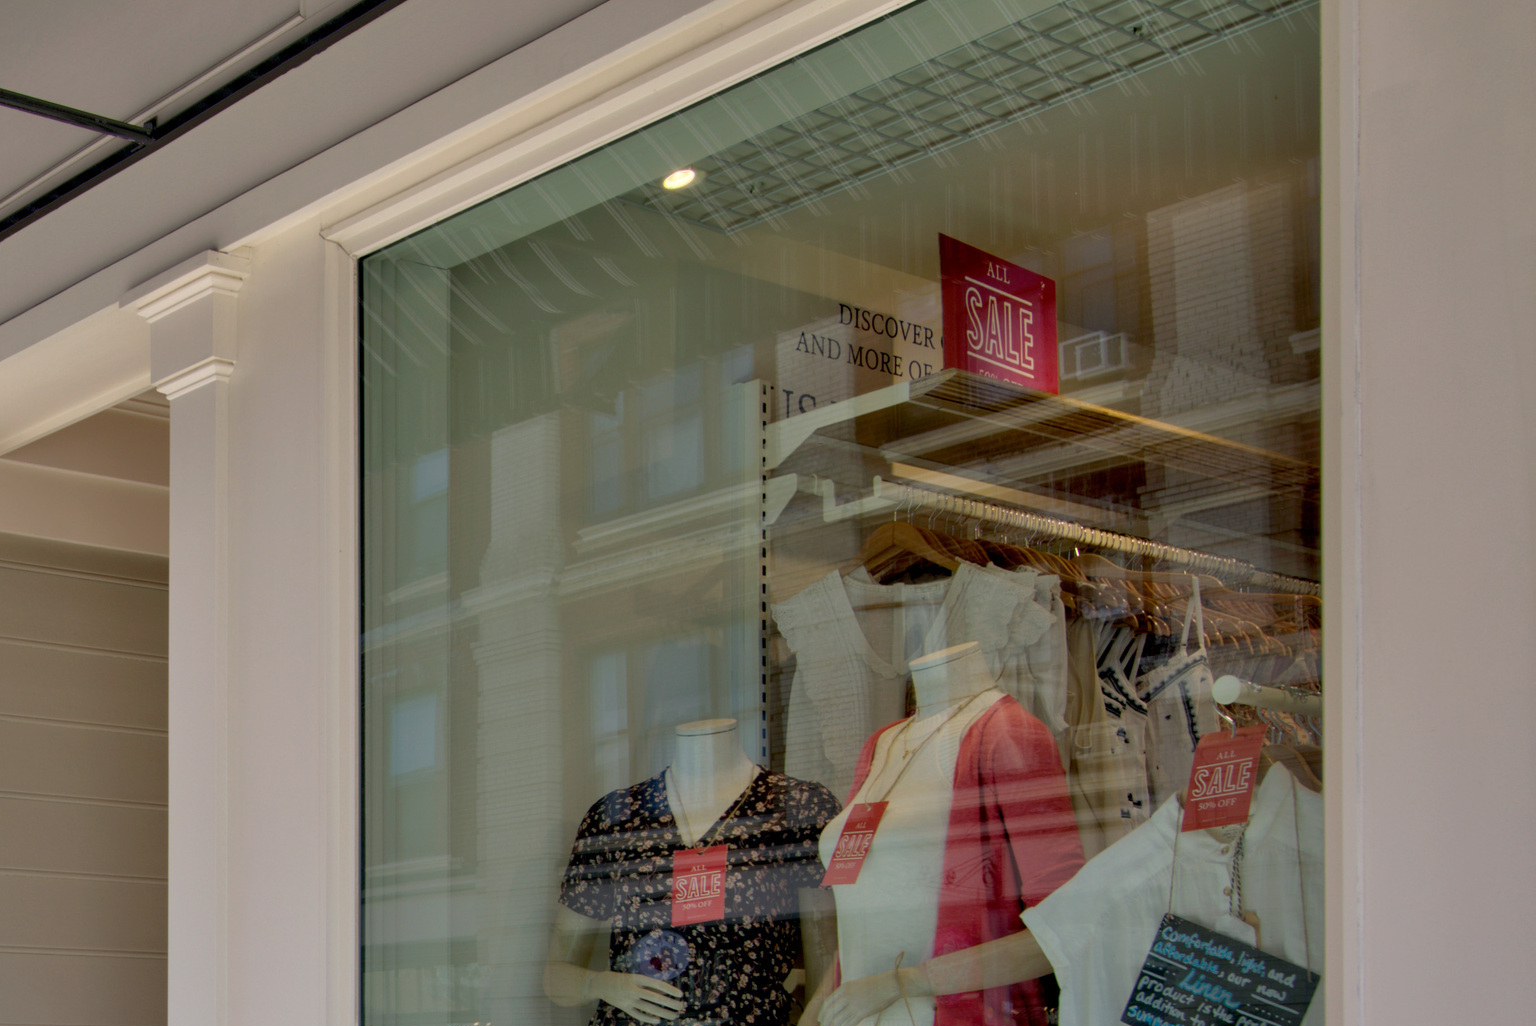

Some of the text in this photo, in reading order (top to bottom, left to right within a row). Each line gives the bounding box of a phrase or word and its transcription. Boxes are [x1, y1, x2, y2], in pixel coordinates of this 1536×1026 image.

[987, 261, 1010, 285] ALL
[838, 303, 935, 350] DISCOVER
[965, 286, 1034, 371] SALE
[795, 330, 933, 380] AND MORE OF
[1217, 750, 1237, 760] ALL
[1192, 761, 1252, 797] SALE
[1198, 797, 1237, 811] 50% OFF
[835, 833, 872, 858] SALE
[676, 873, 720, 900] SALE
[683, 900, 712, 910] 50% OFF
[1137, 975, 1195, 1005] product
[1213, 1005, 1234, 1024] the
[1178, 968, 1240, 1009] Linen
[1227, 973, 1252, 987] our
[1256, 984, 1287, 1001] new
[1135, 991, 1186, 1021] addition
